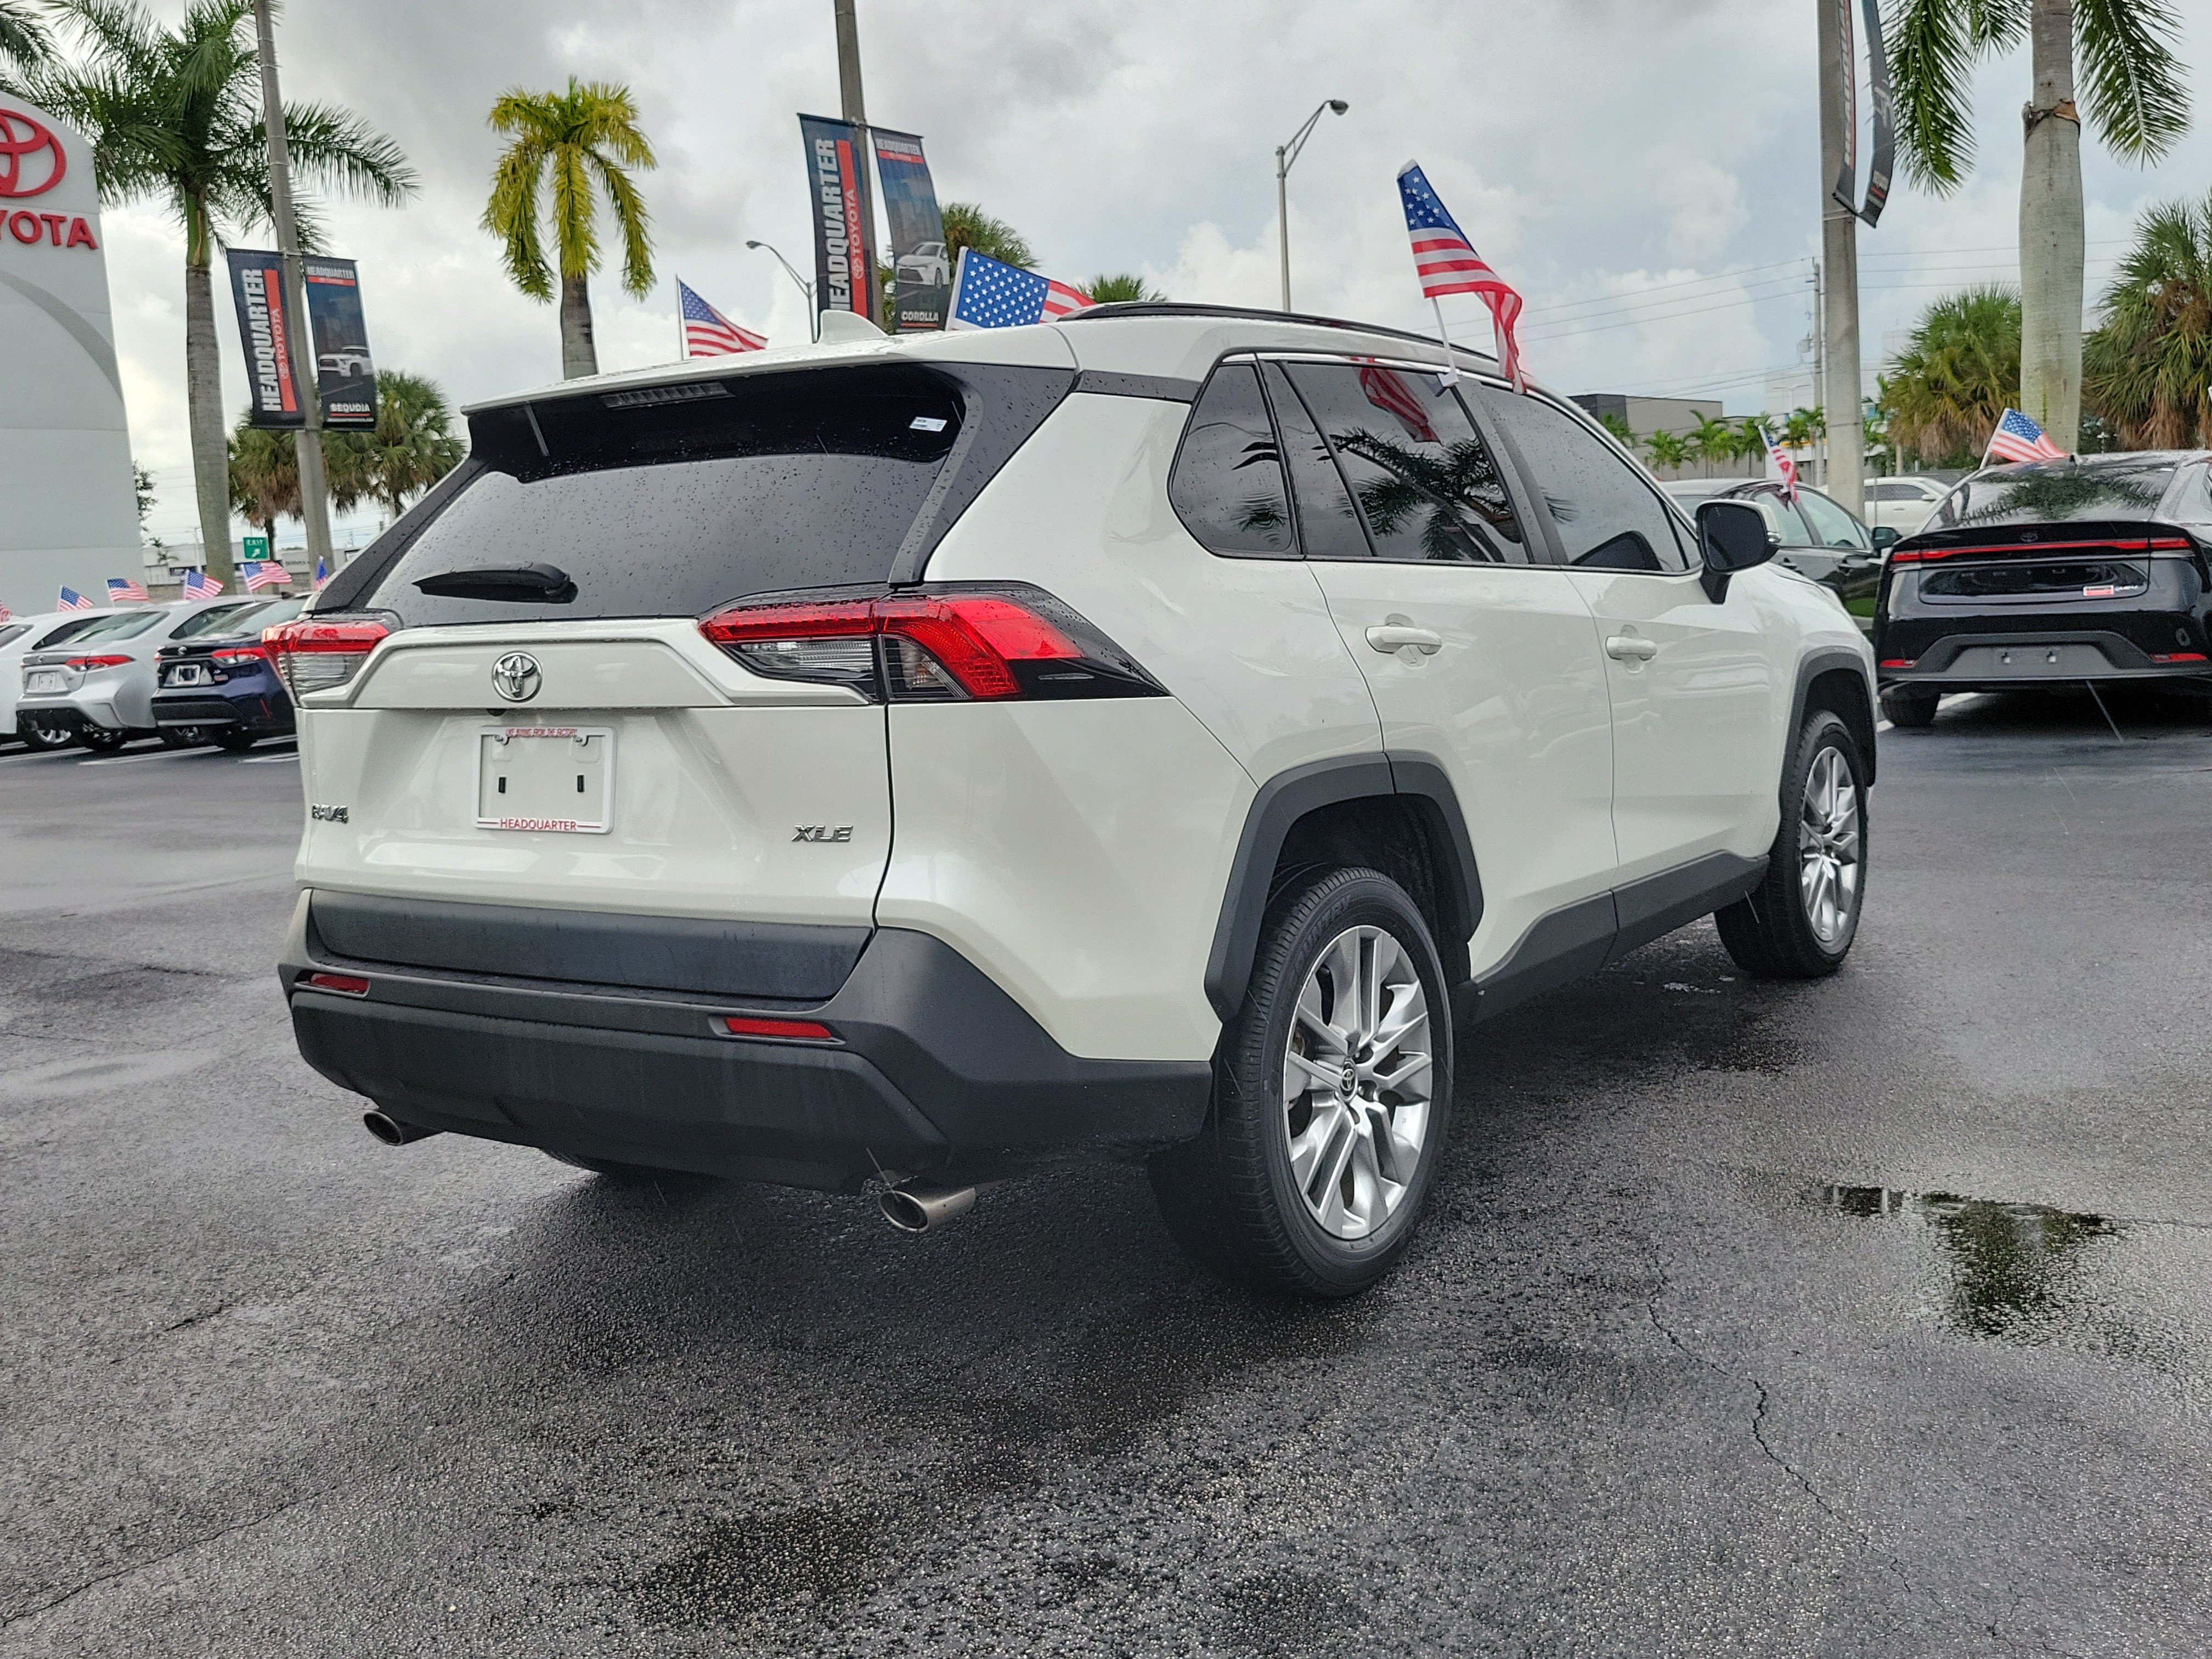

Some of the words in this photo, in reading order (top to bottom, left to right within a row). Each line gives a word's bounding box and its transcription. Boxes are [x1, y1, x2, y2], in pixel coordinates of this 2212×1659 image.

[845, 189, 861, 255] TOYOTA
[900, 310, 939, 321] COROLLA
[242, 268, 283, 411] HEADQUARTER
[271, 308, 287, 360] TOYOTA
[330, 402, 371, 413] SEQUOIA
[312, 803, 348, 823] RAV4
[500, 818, 577, 831] HEADQUARTER
[791, 824, 854, 842] XLE
